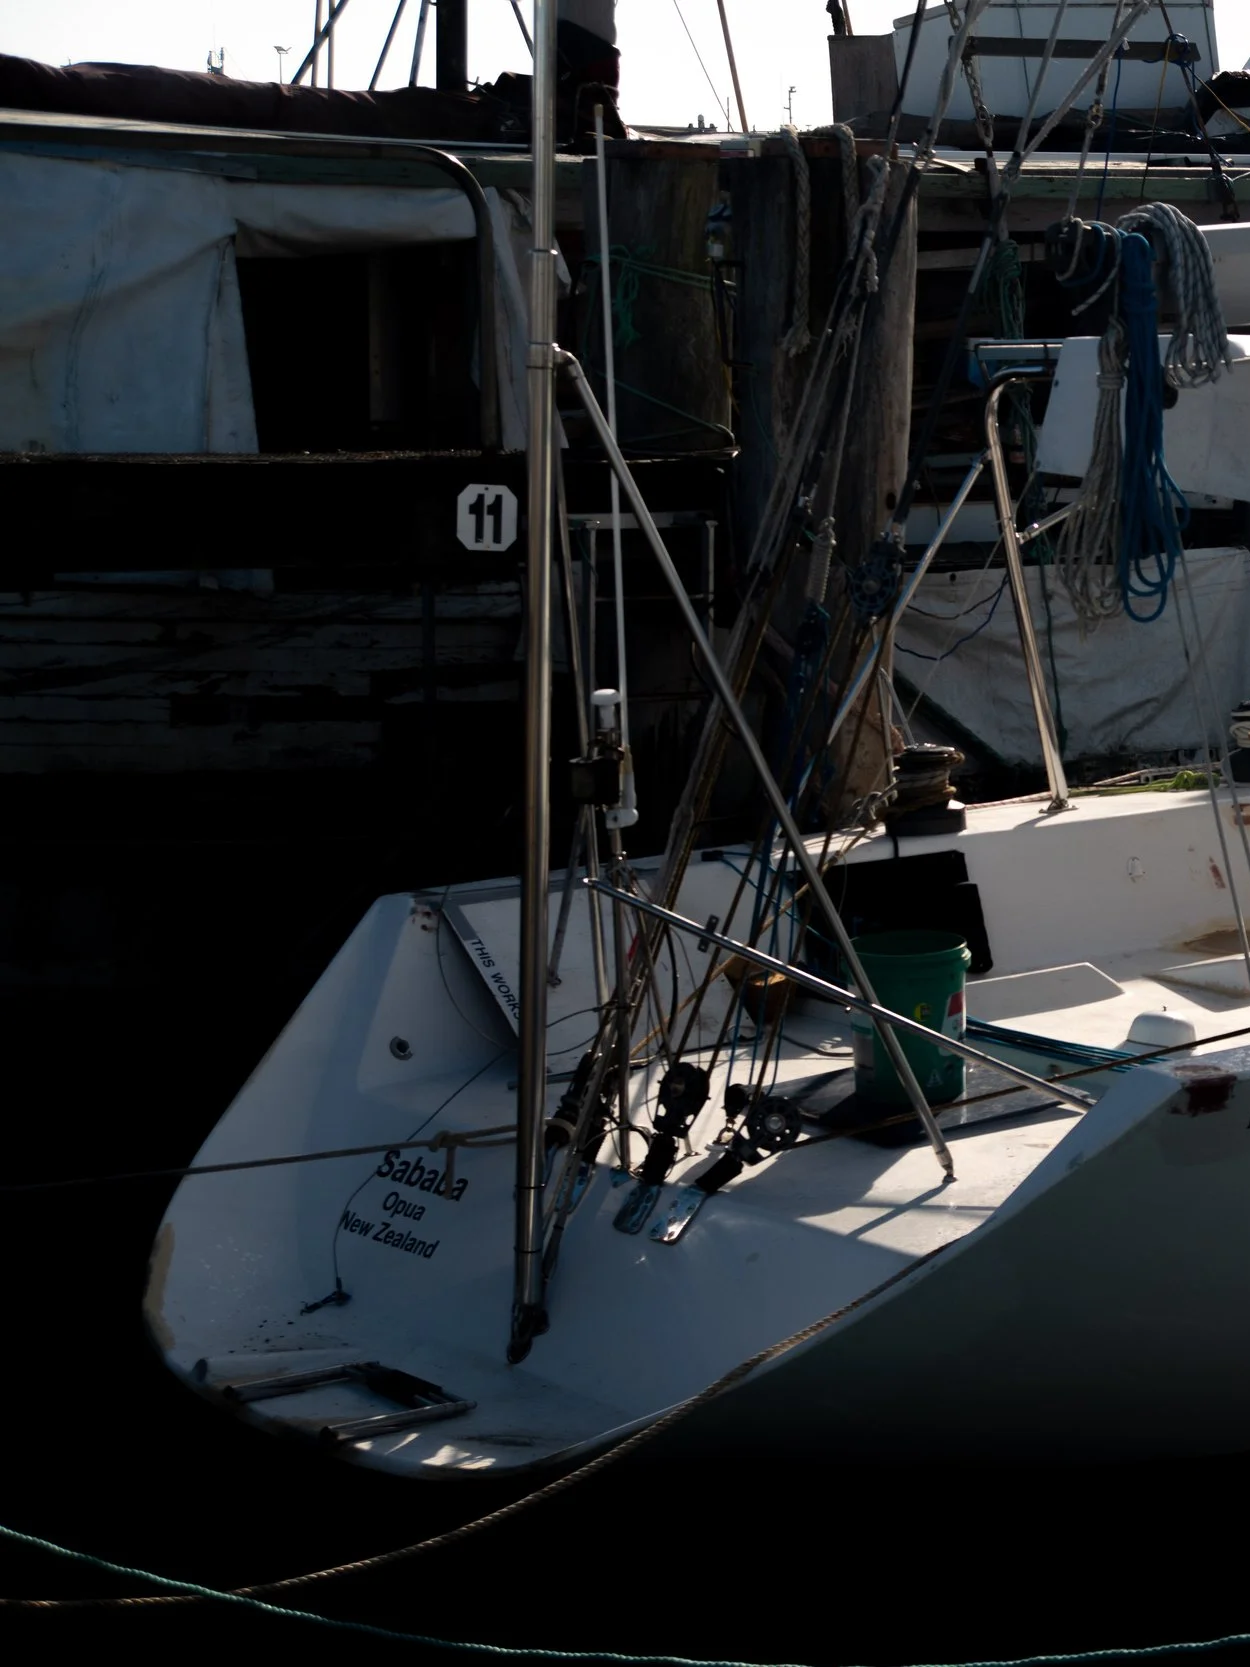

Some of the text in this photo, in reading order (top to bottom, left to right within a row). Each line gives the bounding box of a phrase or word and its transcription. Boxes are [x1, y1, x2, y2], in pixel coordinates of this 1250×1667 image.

[469, 493, 503, 544] 11
[470, 938, 496, 969] THIS
[383, 1191, 426, 1221] Opua
[341, 1211, 440, 1258] New Zealand
